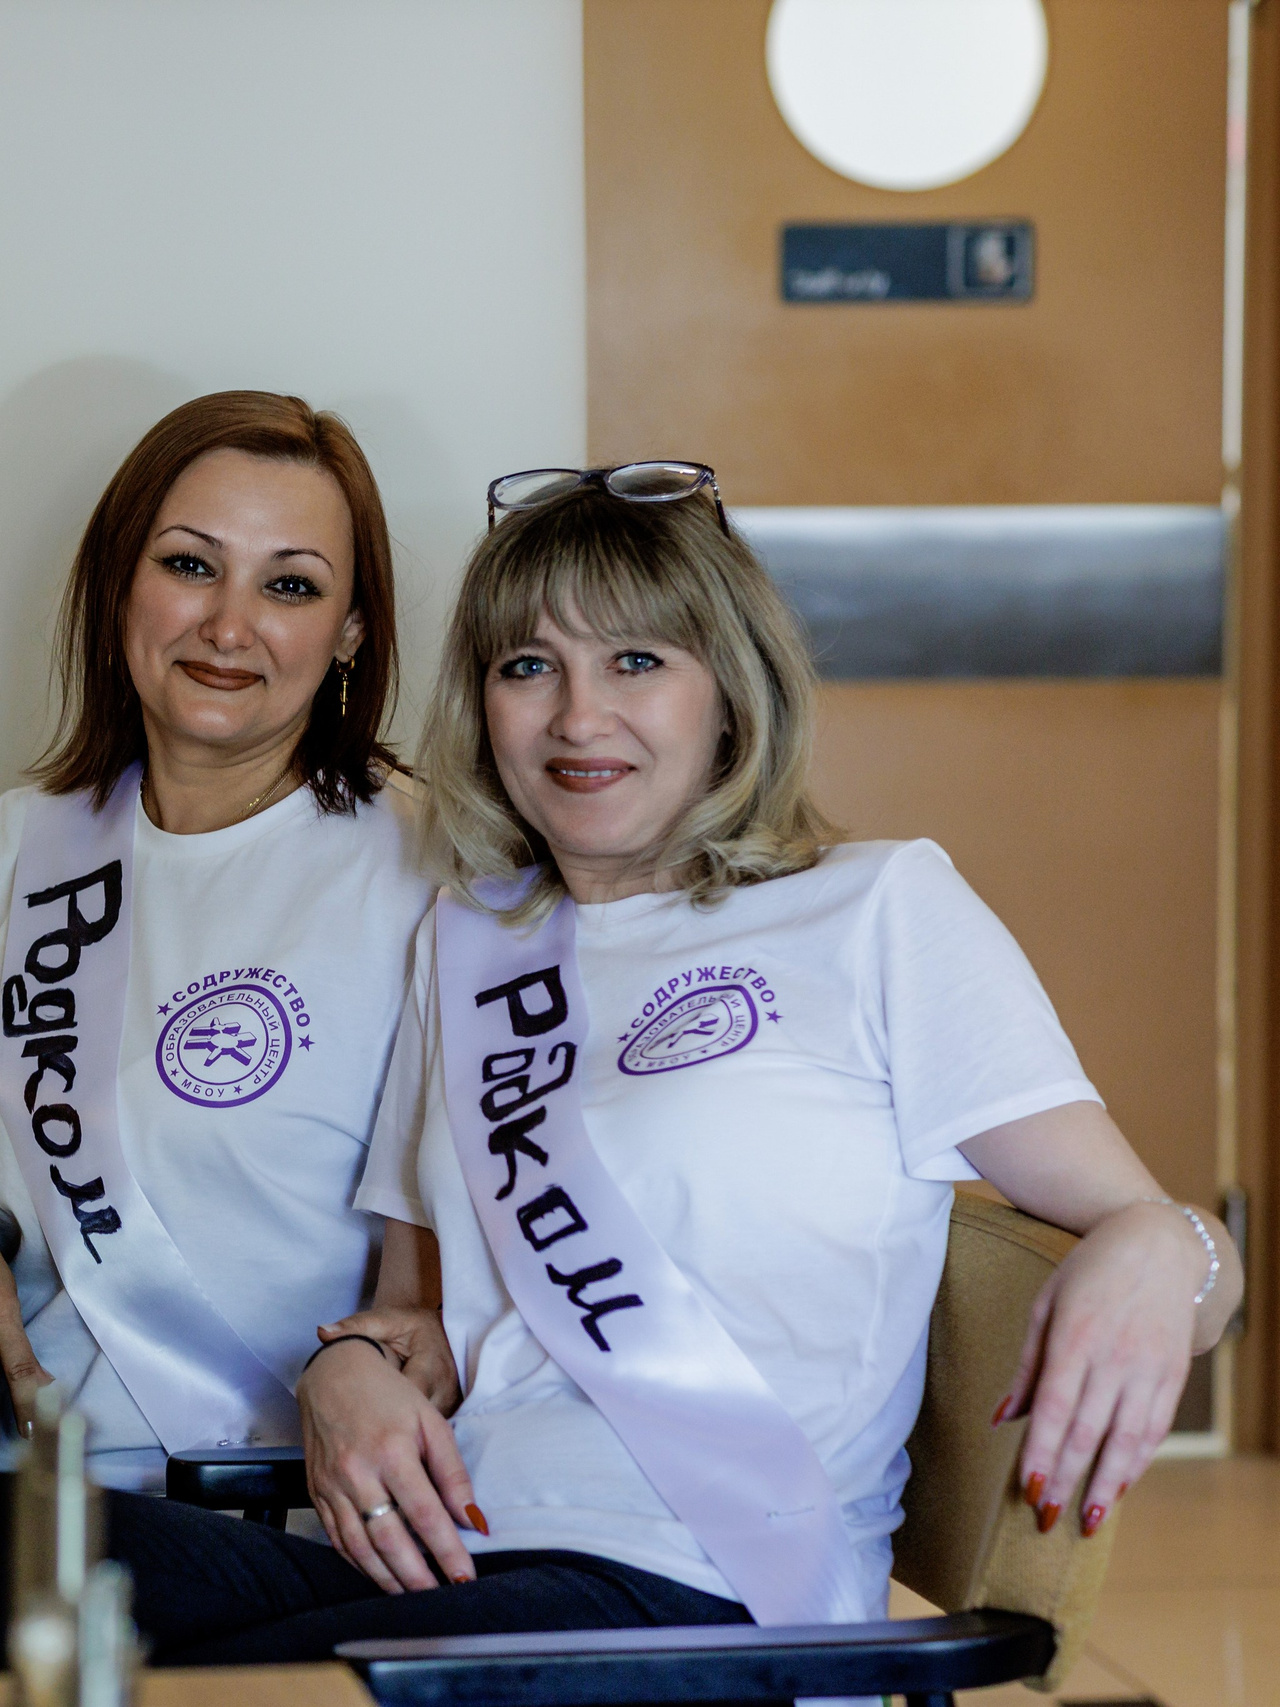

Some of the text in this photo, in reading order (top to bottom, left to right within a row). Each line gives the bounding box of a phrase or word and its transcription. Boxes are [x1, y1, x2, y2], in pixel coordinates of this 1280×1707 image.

[172, 967, 311, 1027] СОДРУЖЕСТВО
[630, 966, 775, 1028] СОДРУЖЕСТВО
[165, 992, 281, 1085] ОБРАЗОВАТЕЛЬНЫЙ ЦЕНТР
[181, 1078, 225, 1097] МБОУ
